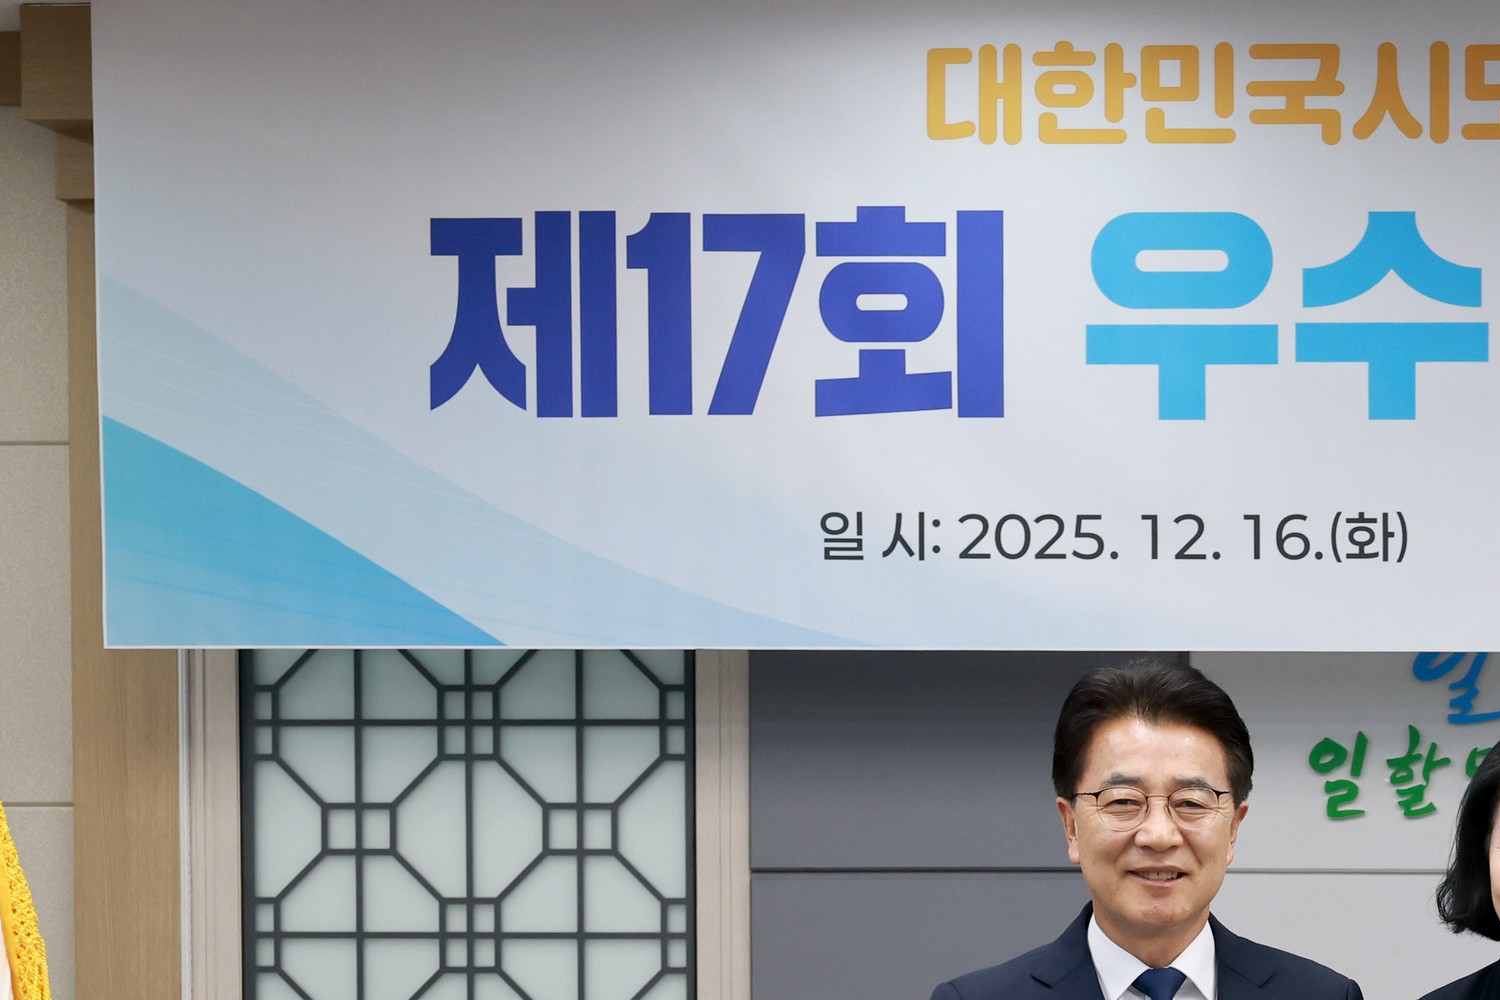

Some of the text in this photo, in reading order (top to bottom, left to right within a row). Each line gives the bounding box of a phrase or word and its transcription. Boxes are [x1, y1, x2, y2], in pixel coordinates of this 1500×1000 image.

[430, 205, 1005, 418] 제17회
[957, 512, 1120, 561] 2025.
[1140, 513, 1221, 561] 12.
[1242, 509, 1409, 564] 16.(화)
